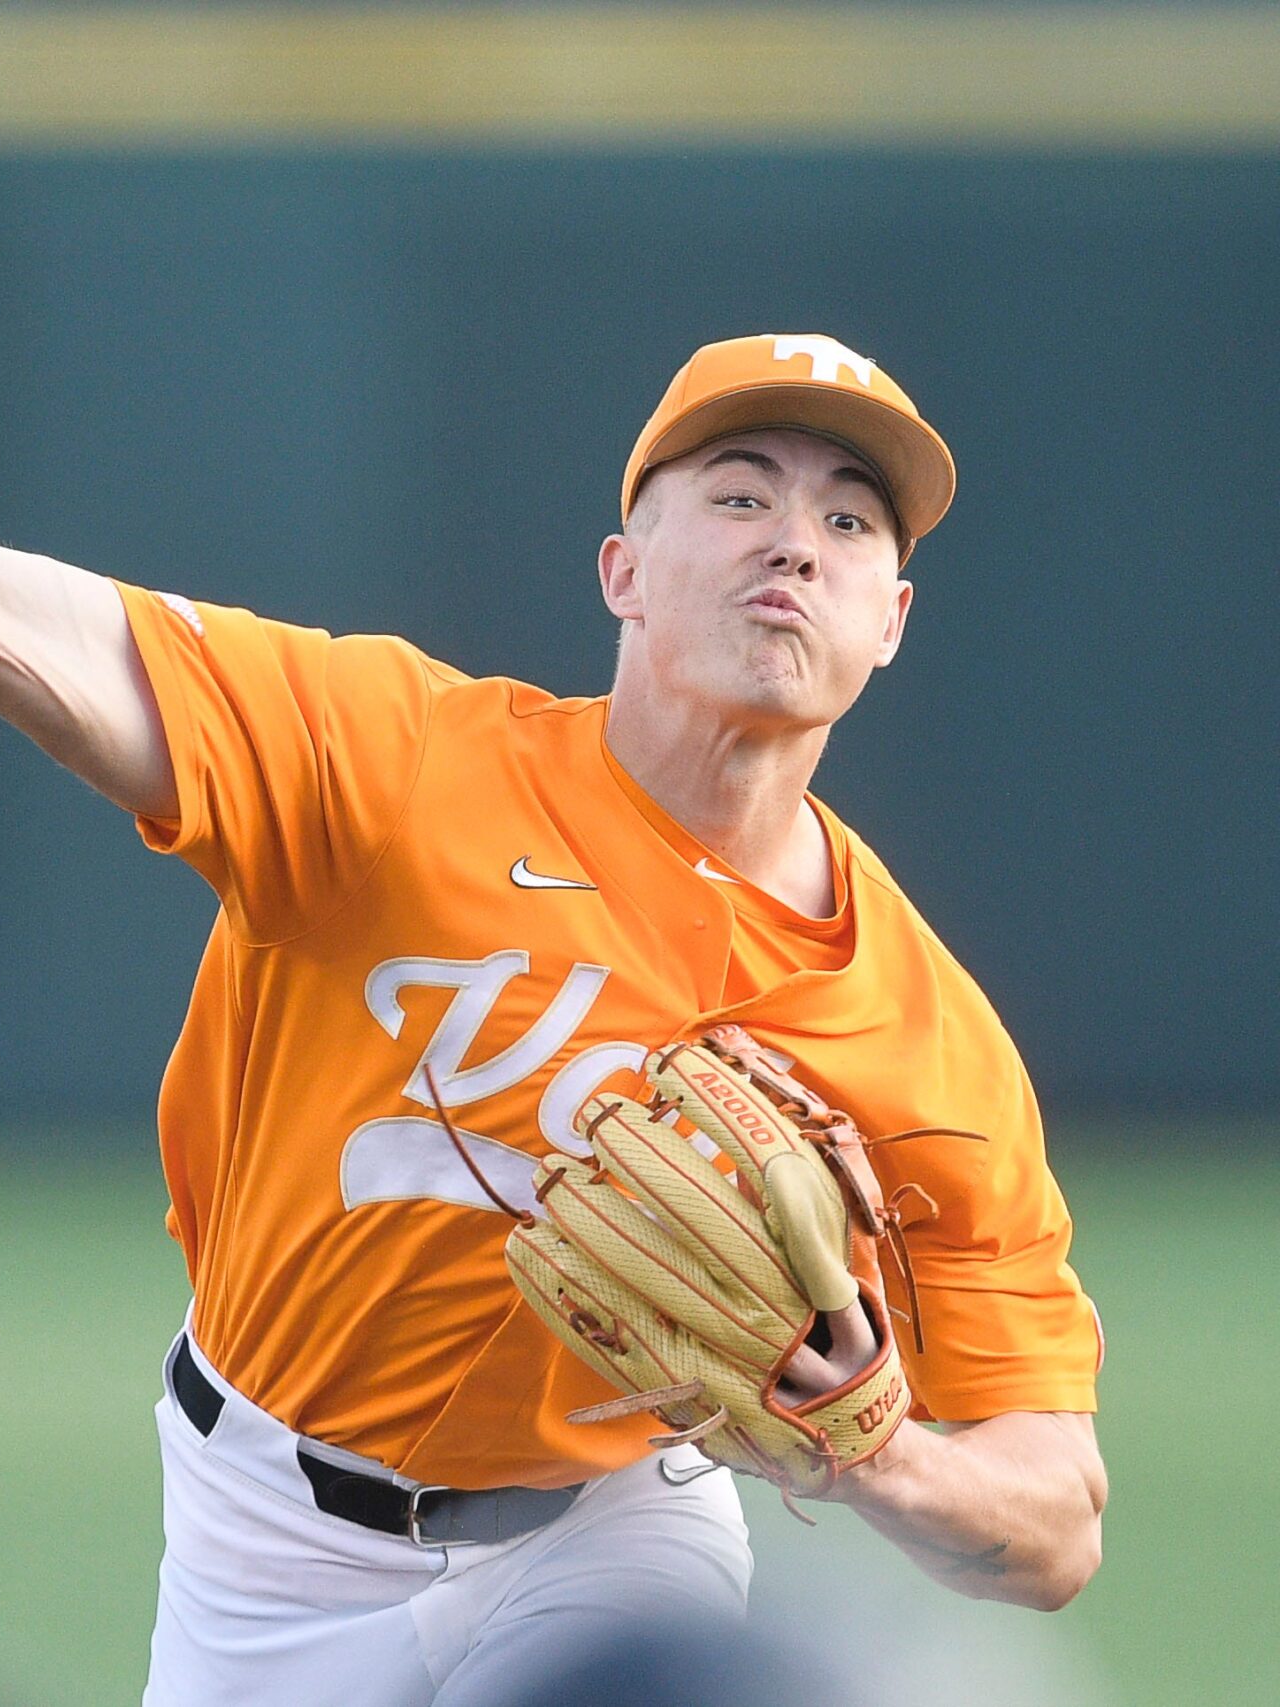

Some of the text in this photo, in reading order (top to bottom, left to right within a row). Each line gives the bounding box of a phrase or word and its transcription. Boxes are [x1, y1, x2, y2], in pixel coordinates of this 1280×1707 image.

[773, 337, 871, 388] T
[364, 948, 652, 1158] Vo
[690, 1072, 775, 1145] A2000
